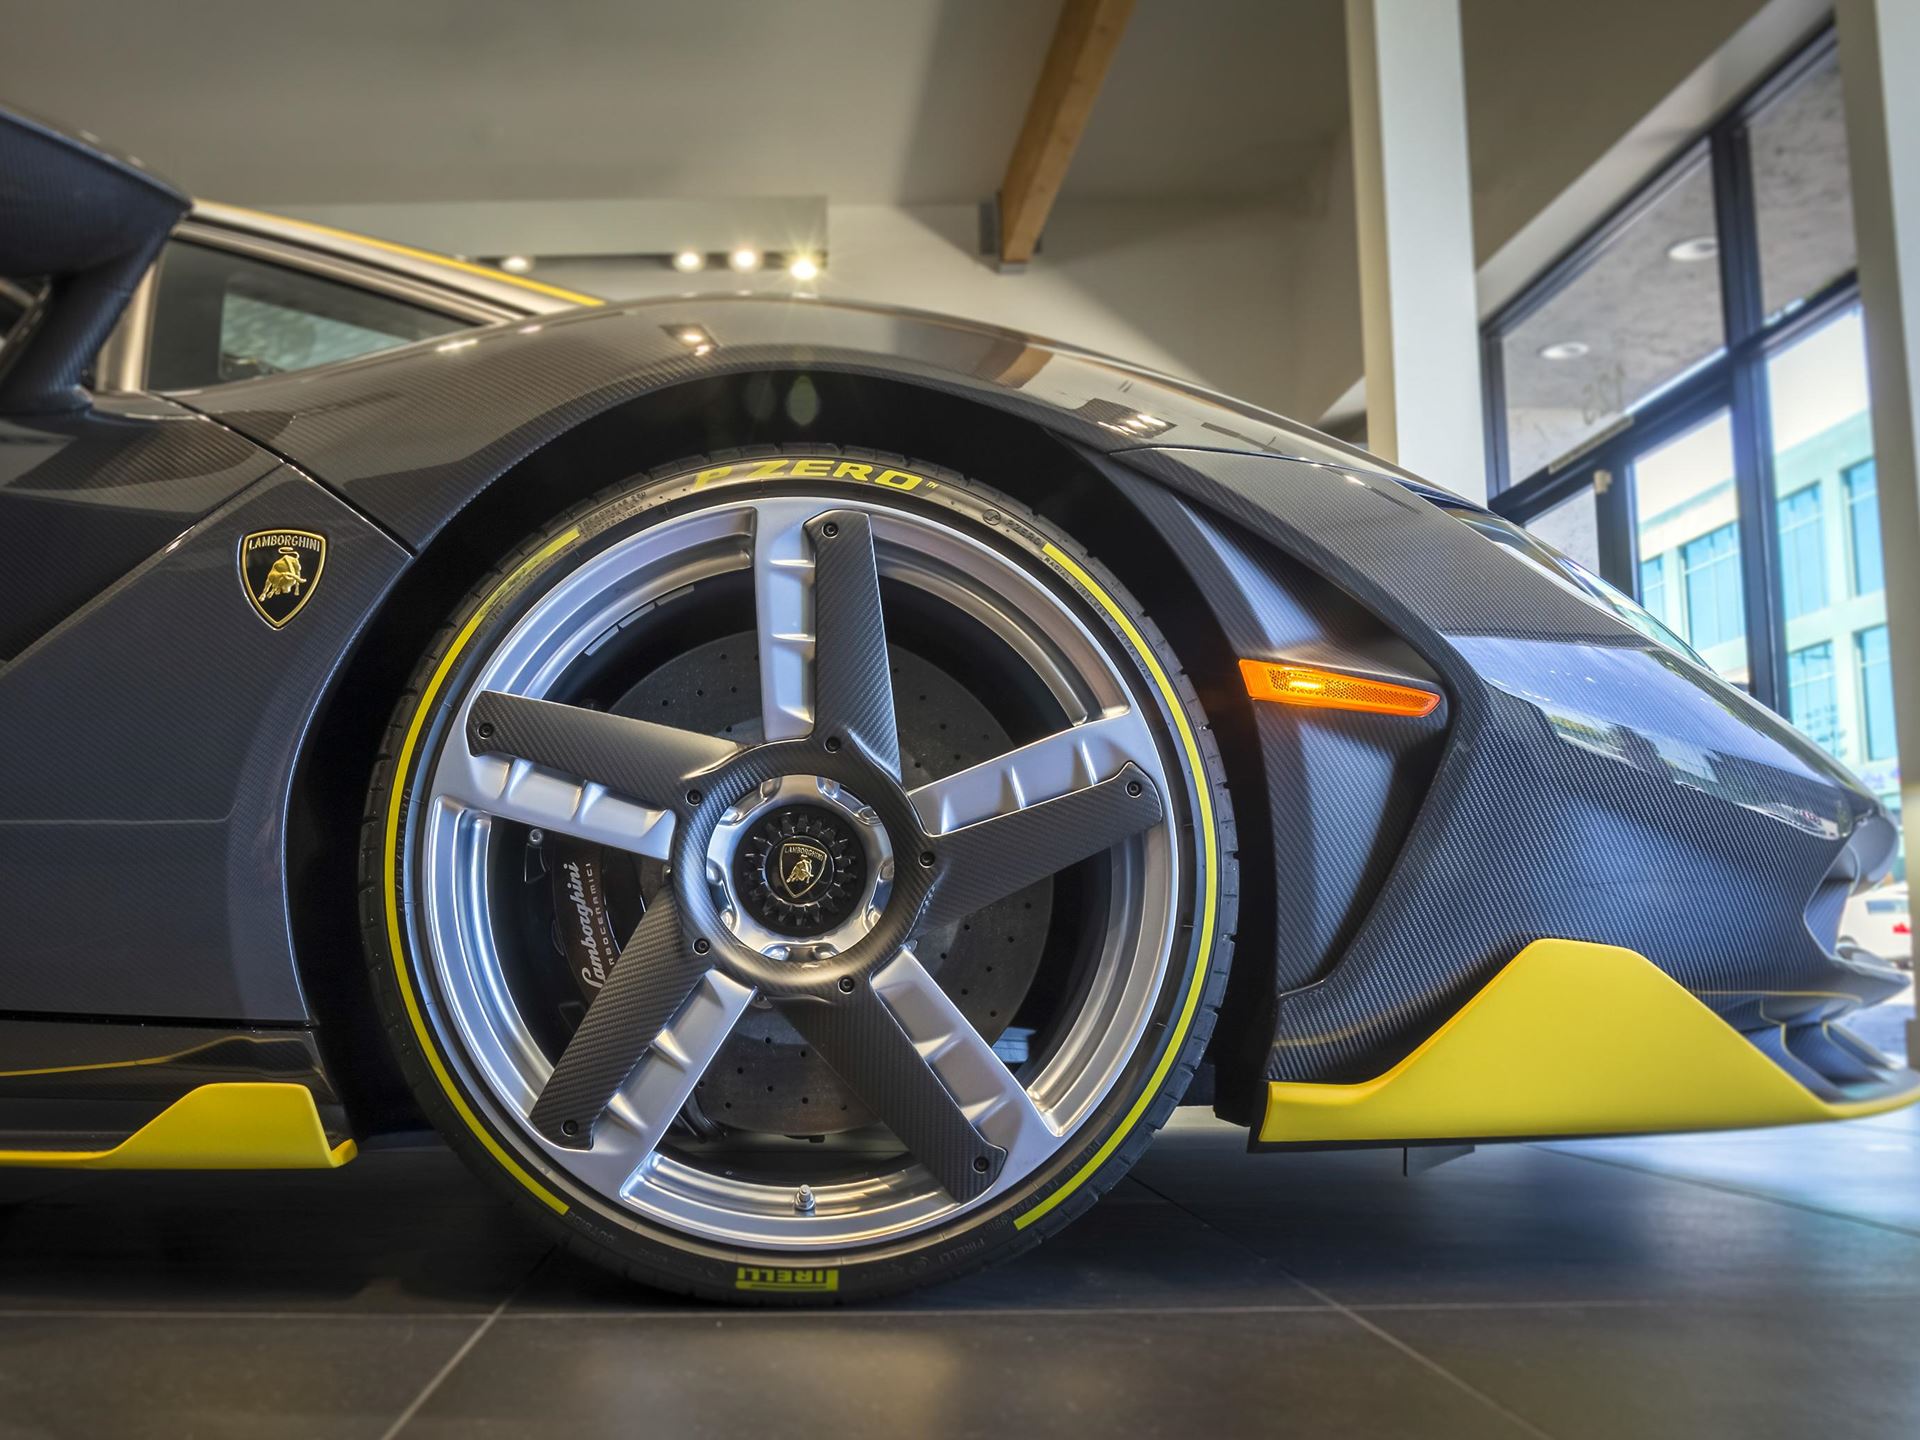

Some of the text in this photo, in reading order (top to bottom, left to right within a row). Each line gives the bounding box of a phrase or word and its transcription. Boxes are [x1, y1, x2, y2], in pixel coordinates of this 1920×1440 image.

[693, 466, 733, 493] P
[248, 535, 321, 552] LAMBORGHINI
[1043, 556, 1070, 579] RADIAL
[563, 861, 607, 989] Lamborghini
[735, 1267, 839, 1291] PIRELLI
